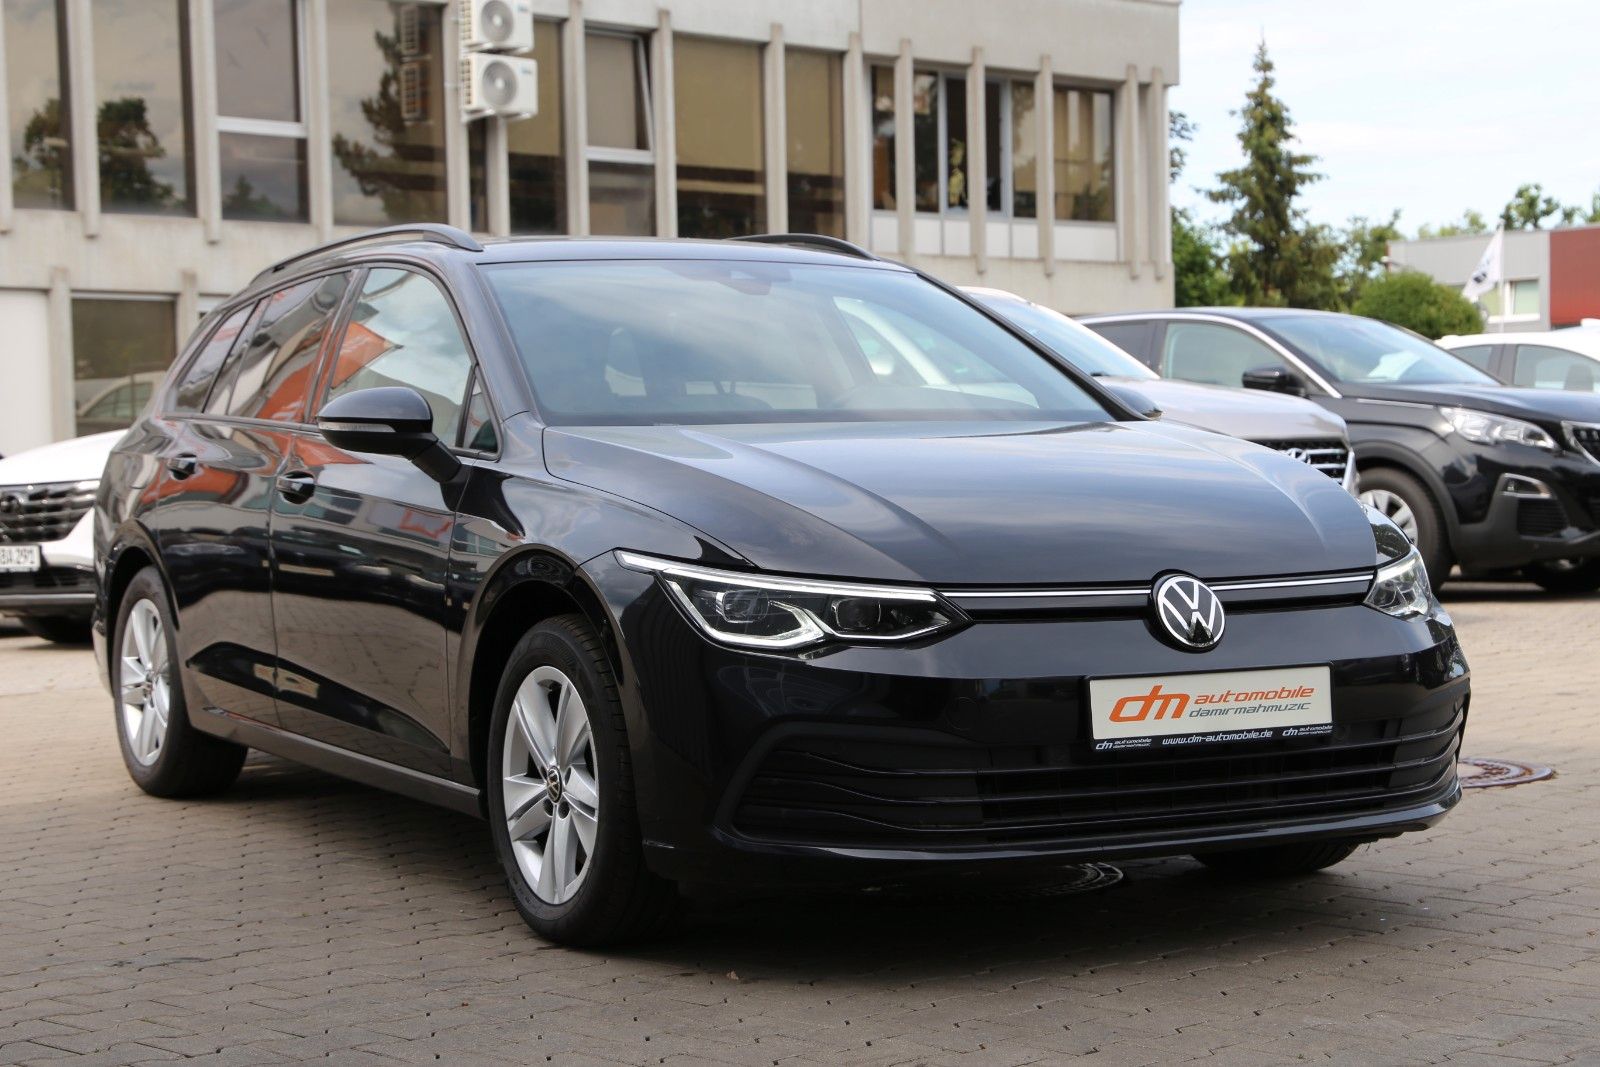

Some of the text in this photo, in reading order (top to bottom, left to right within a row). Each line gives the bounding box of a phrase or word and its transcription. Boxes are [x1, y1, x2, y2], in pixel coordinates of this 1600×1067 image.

[1109, 684, 1315, 723] dm automobile
[1189, 702, 1311, 718] damirmahmuzic
[1162, 729, 1273, 745] www.dm-automobile.de
[1282, 727, 1299, 737] dm
[1095, 740, 1113, 750] dm
